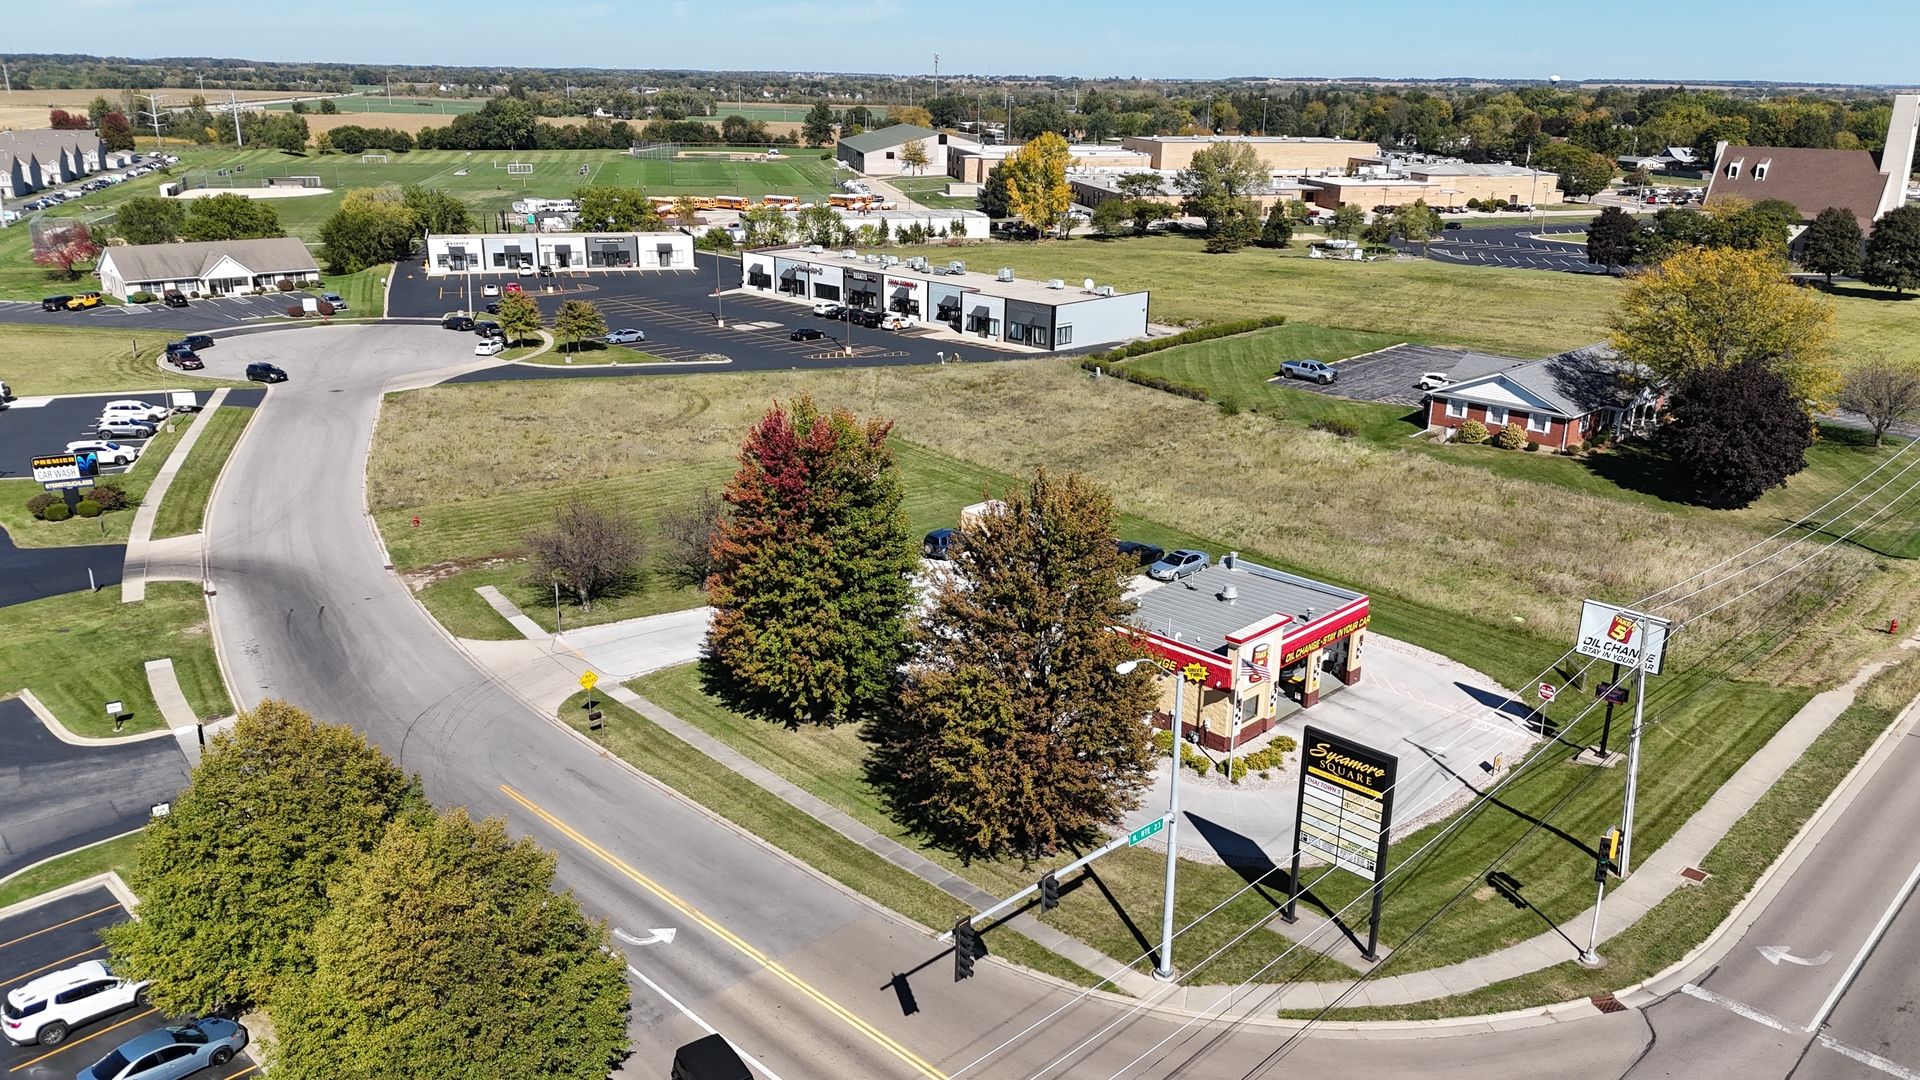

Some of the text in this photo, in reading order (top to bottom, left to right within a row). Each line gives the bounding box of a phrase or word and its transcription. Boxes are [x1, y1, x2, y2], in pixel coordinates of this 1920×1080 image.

[33, 457, 75, 466] PREMIER
[37, 469, 77, 480] CAR WASH
[1615, 615, 1633, 627] TAKE
[1285, 651, 1296, 662] OIL
[1296, 639, 1321, 658] CHANGE
[1322, 630, 1337, 645] STAY
[1344, 621, 1359, 635] YOUR
[1359, 615, 1371, 627] CAR
[1610, 624, 1627, 641] 5
[1581, 645, 1602, 656] STAY
[1602, 651, 1612, 660] IN
[1613, 654, 1636, 666] YOUR
[1583, 636, 1656, 663] OIL CHANE
[1309, 743, 1386, 777] Sycamore
[1320, 759, 1372, 786] SQUARE
[1307, 776, 1320, 786] THAI
[1320, 781, 1336, 792] TOWN
[1141, 827, 1151, 838] RTE
[1153, 822, 1161, 831] 23
